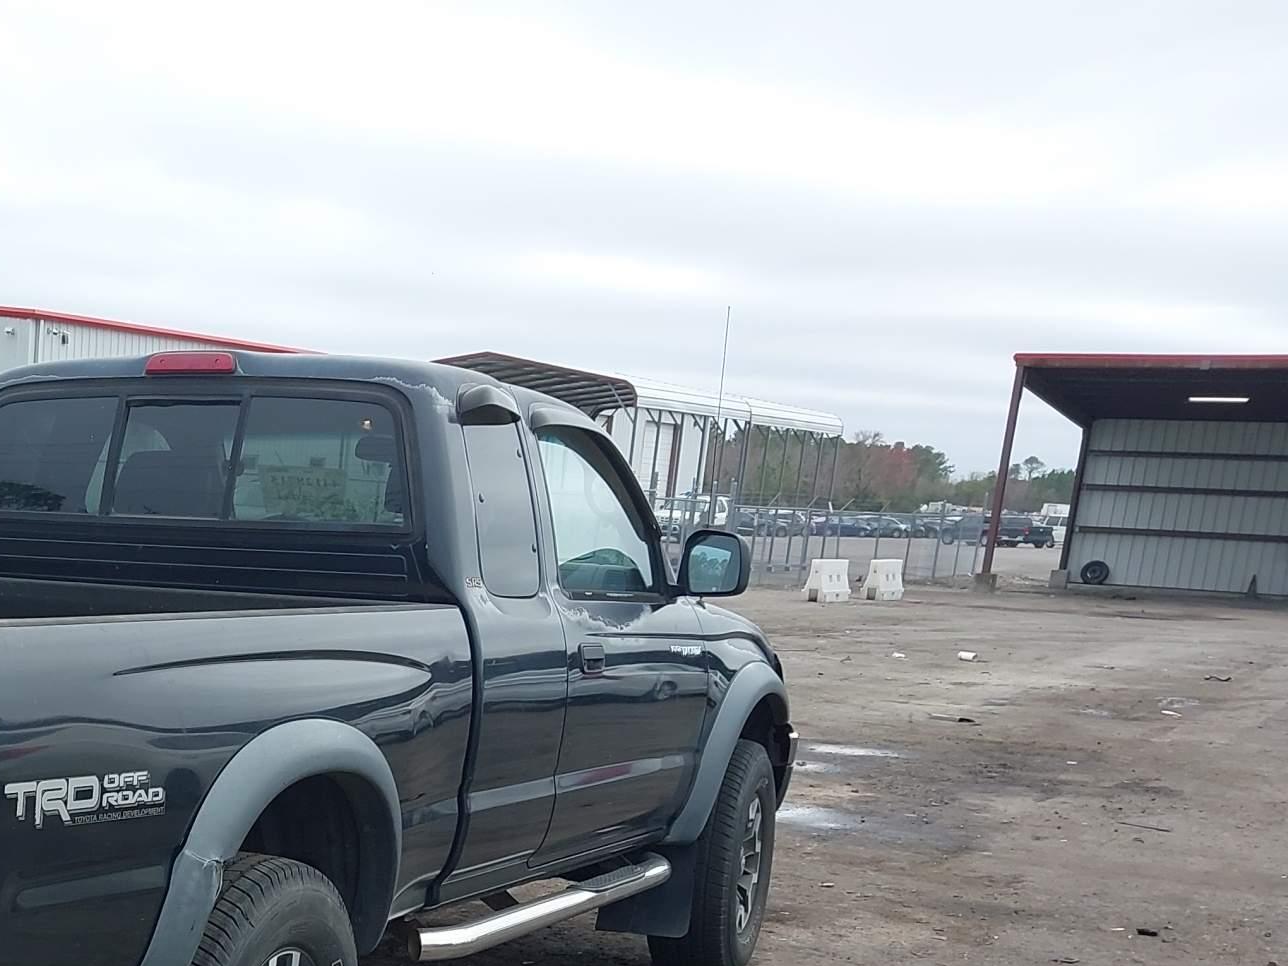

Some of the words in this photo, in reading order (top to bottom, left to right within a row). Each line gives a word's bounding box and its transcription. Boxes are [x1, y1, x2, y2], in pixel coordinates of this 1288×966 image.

[103, 770, 150, 790] OFF
[5, 775, 101, 829] TRD
[102, 787, 166, 809] ROAD
[74, 814, 98, 825] TOYOTA
[99, 812, 122, 821] RACING
[123, 806, 165, 819] DEVELOPMENT
